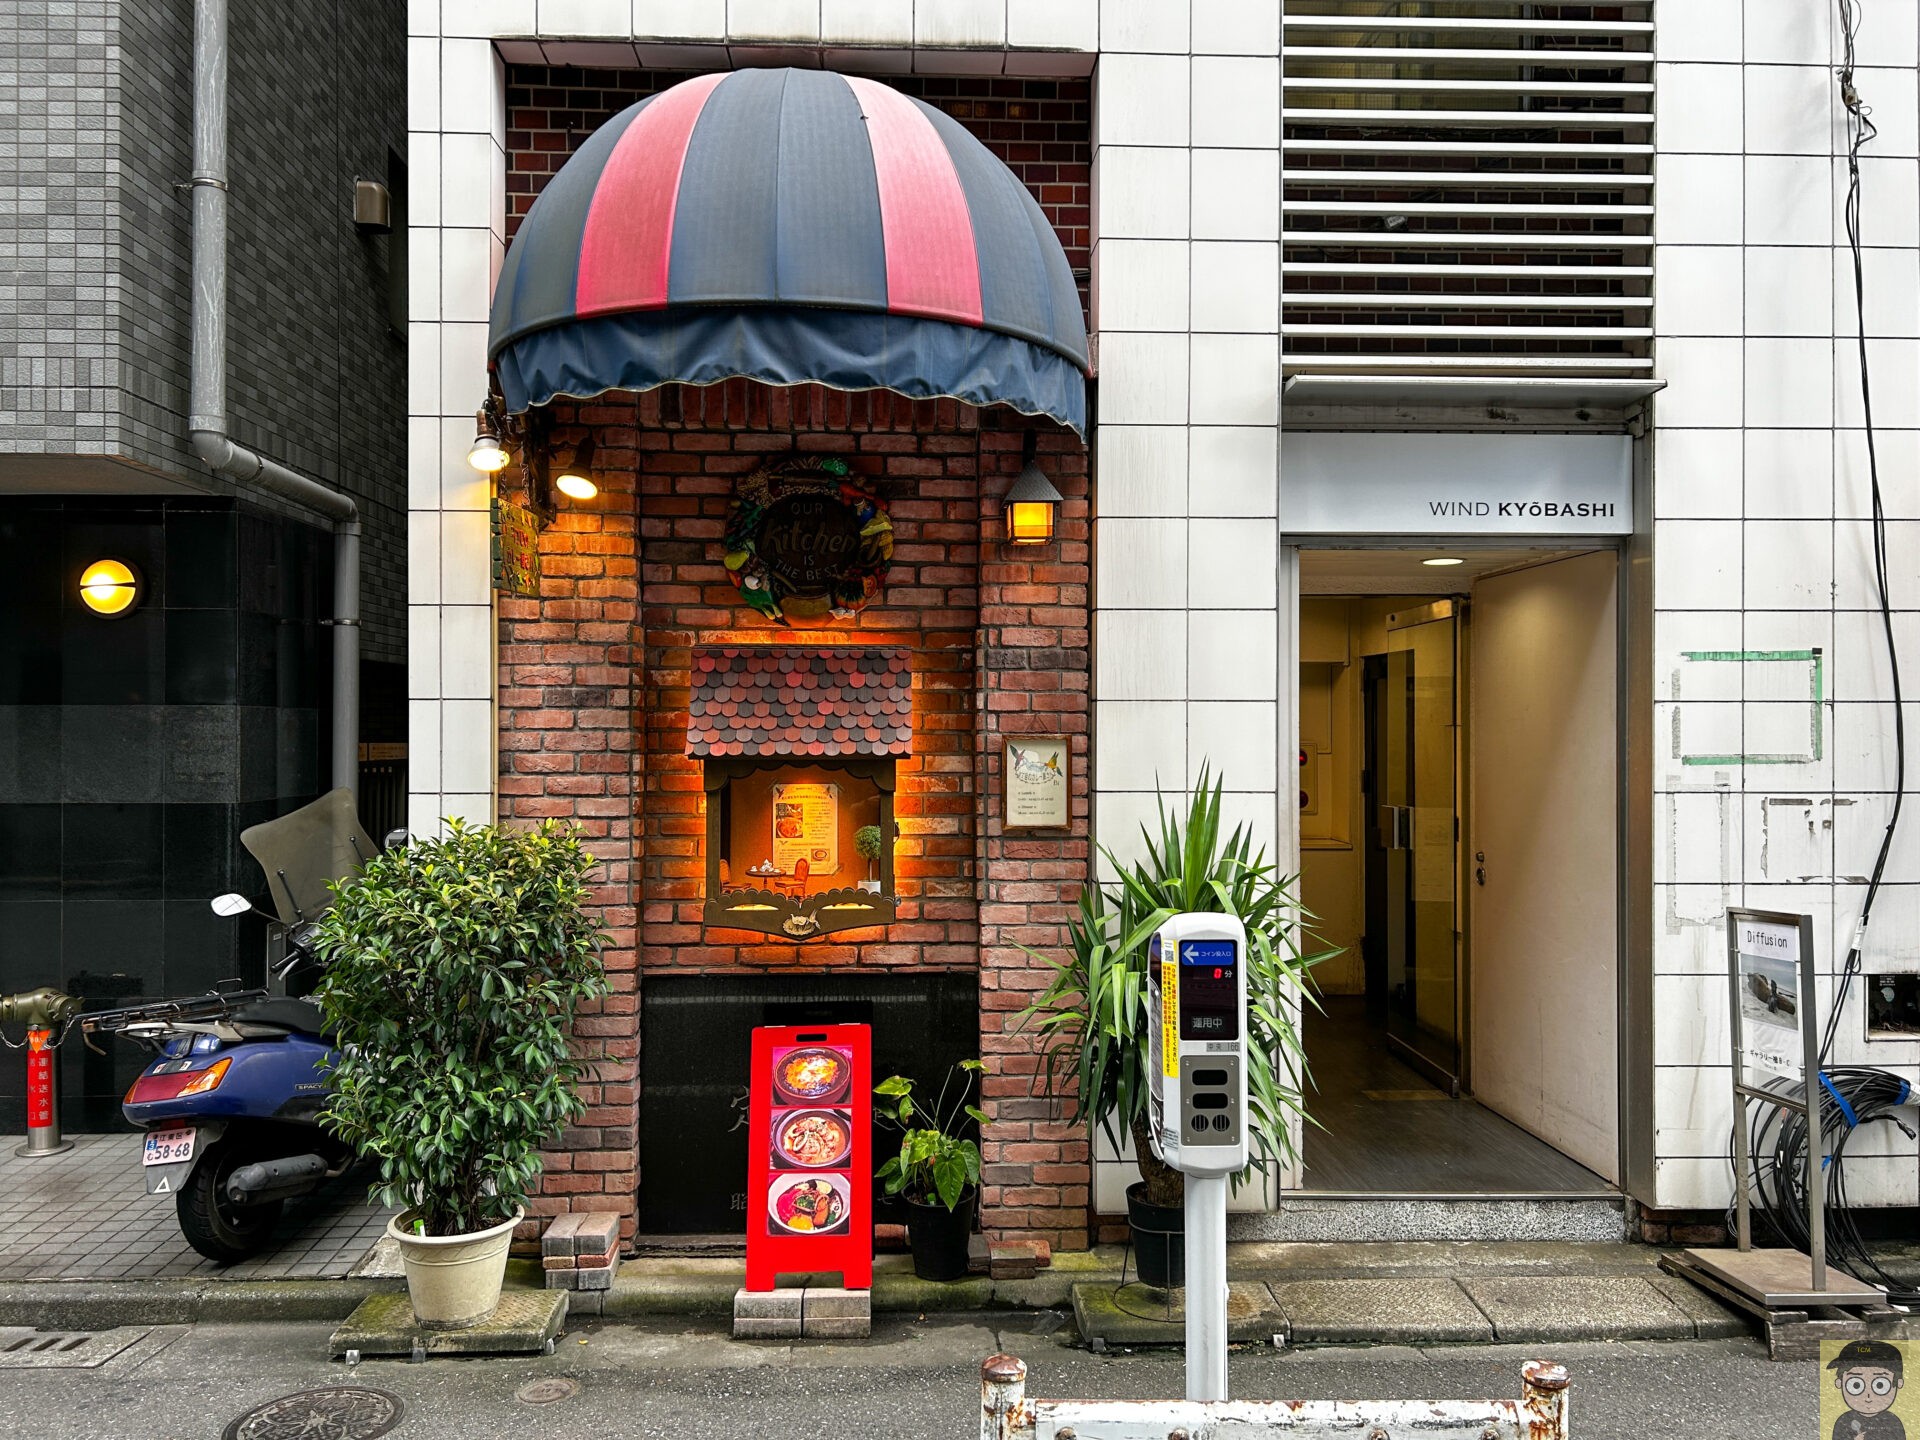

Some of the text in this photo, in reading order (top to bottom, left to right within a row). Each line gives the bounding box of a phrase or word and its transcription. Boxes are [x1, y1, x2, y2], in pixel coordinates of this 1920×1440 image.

[791, 502, 824, 515] OUR
[1429, 502, 1490, 516] WIND
[803, 554, 815, 566] IS
[775, 558, 840, 581] THE BEST
[1747, 930, 1788, 949] Diffusion
[1213, 968, 1233, 979] 0 分
[1192, 1017, 1223, 1028] 運用中
[38, 1057, 49, 1120] 連結送水管
[160, 1132, 184, 1142] 江東区
[155, 1142, 190, 1160] 58-68
